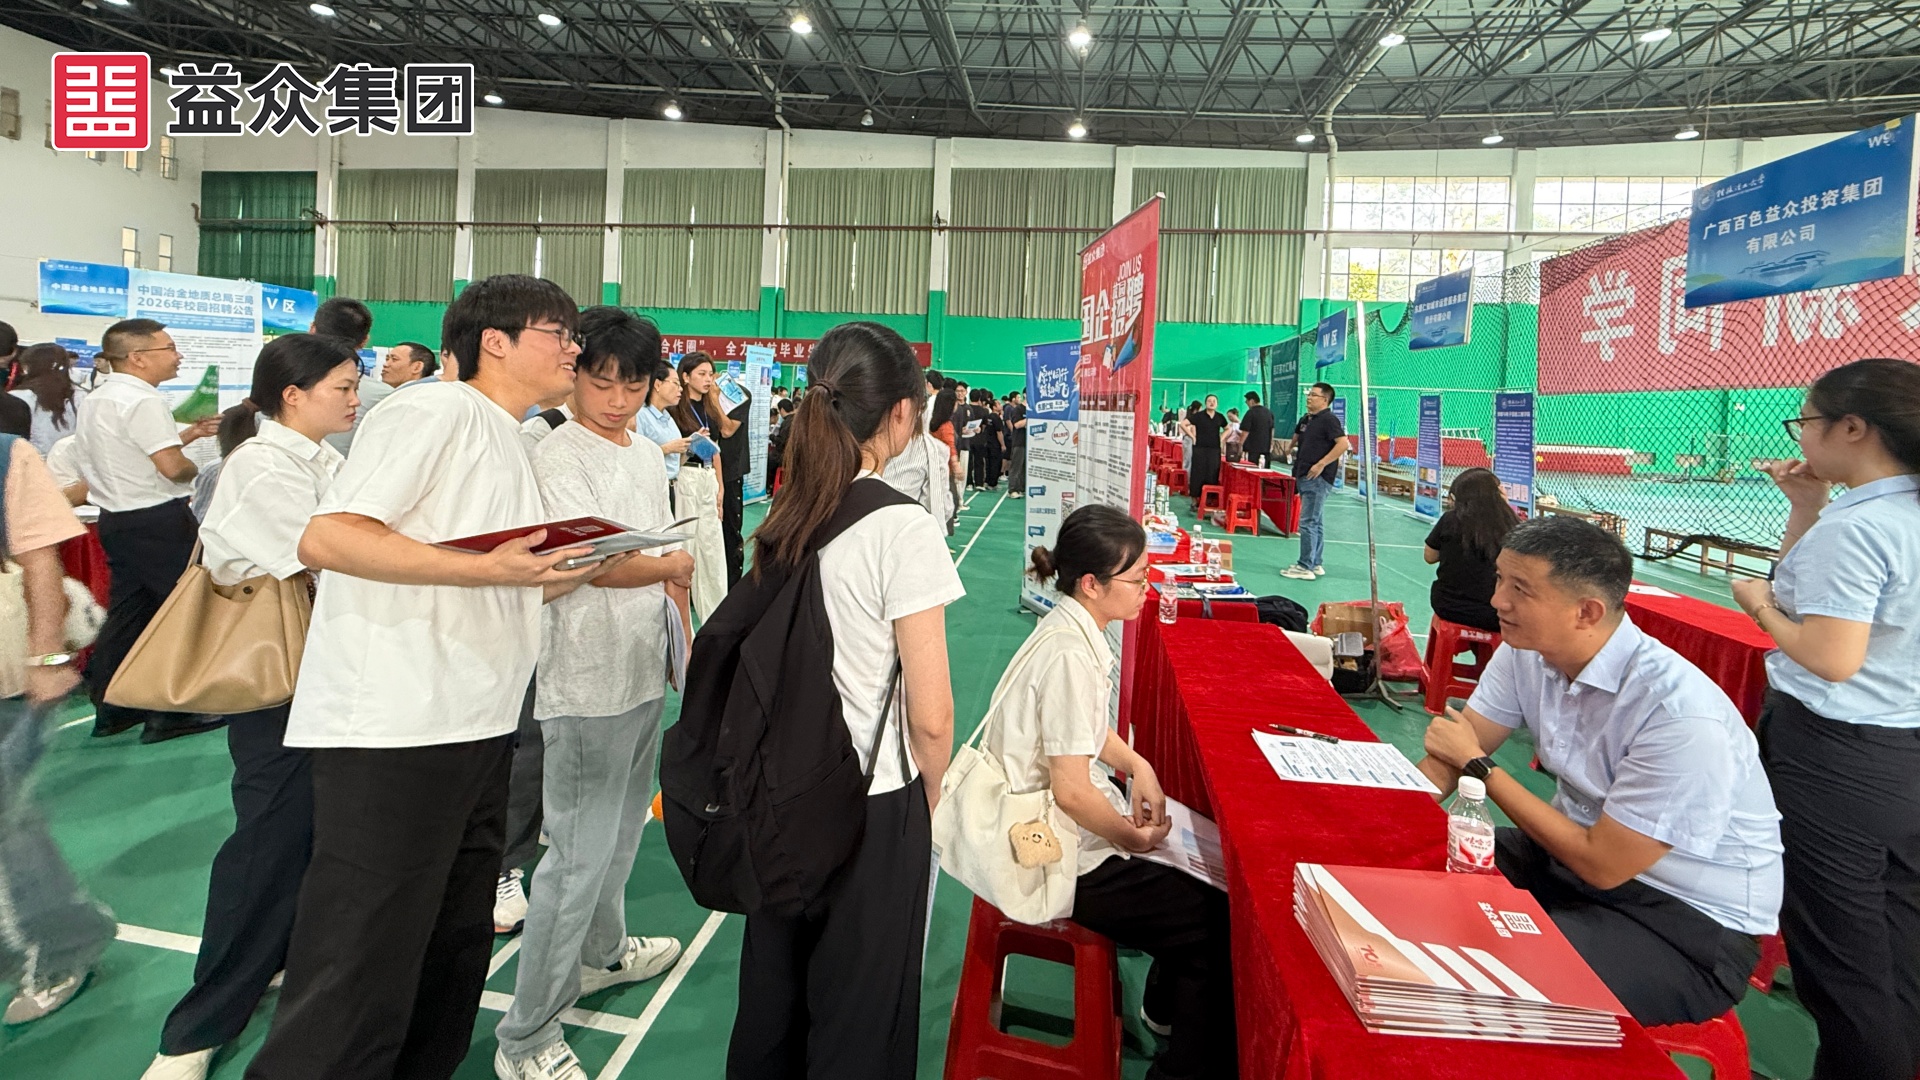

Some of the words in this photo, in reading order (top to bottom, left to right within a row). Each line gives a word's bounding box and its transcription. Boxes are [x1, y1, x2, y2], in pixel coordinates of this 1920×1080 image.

[1702, 176, 1884, 240] 广西百色益众投资集团
[1746, 223, 1816, 255] 有限公司
[1117, 259, 1132, 282] JOIN
[1132, 253, 1143, 275] US
[137, 284, 254, 305] 中国冶金地质总局三局
[137, 296, 254, 316] 2026年校园招聘公告
